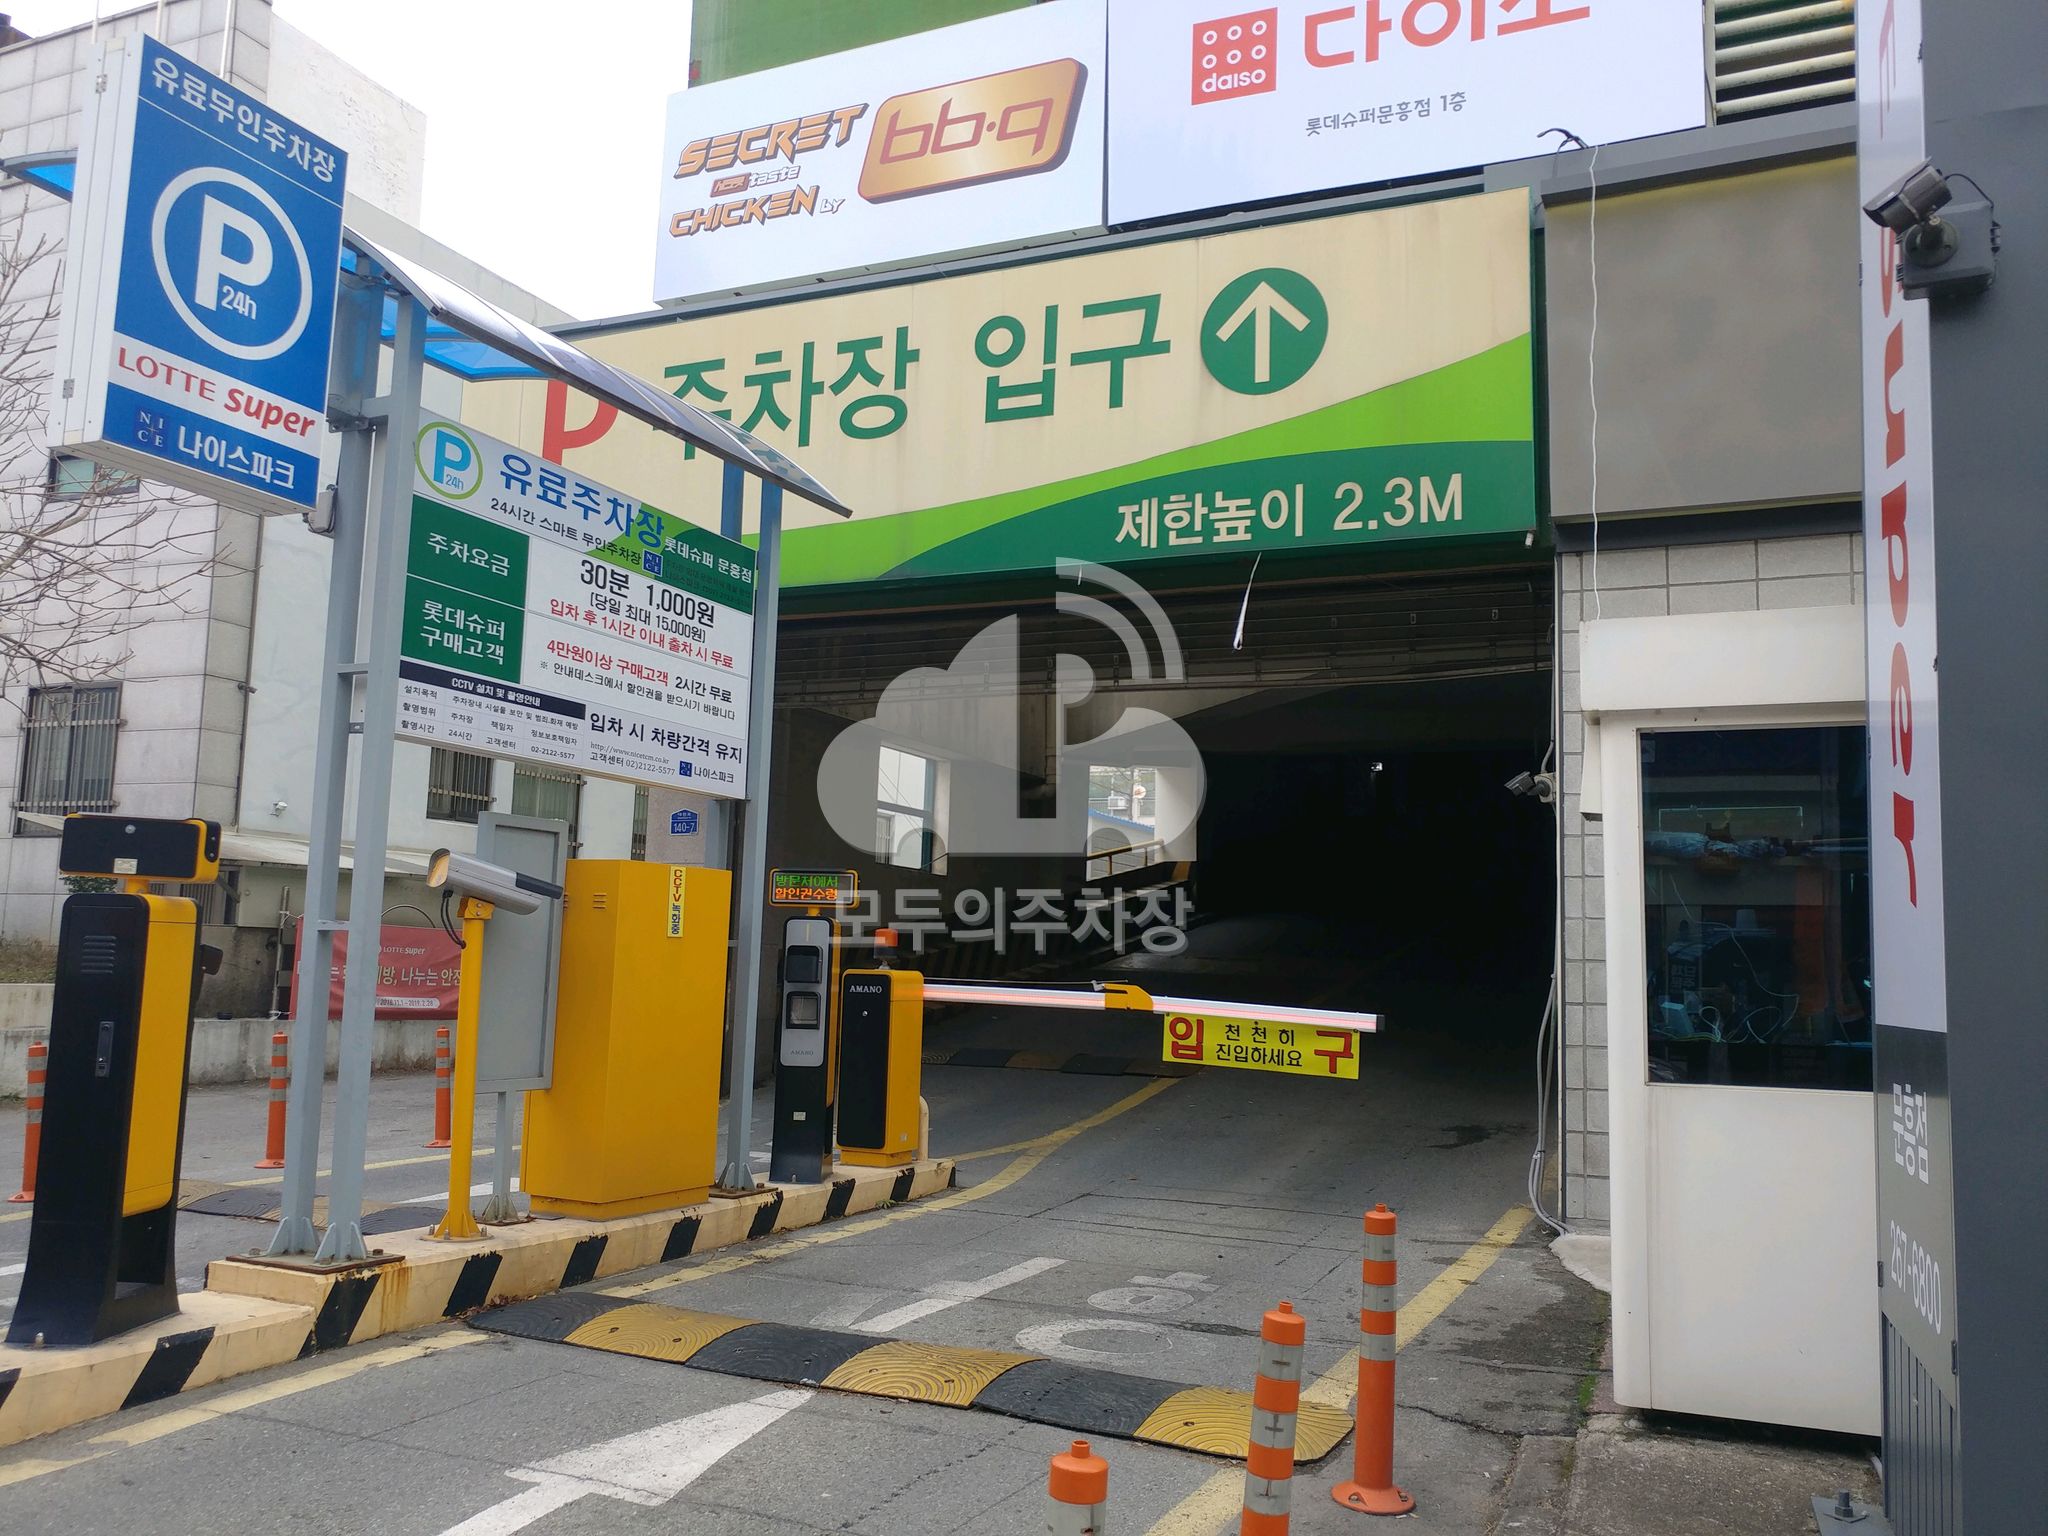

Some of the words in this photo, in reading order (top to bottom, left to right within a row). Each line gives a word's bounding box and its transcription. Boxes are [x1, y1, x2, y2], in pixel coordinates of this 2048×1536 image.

[1201, 69, 1266, 93] daiso
[152, 57, 336, 183] 유료무인주차장
[1305, 98, 1431, 137] 롯데슈퍼문흥점
[1439, 91, 1467, 112] 1층
[673, 102, 869, 179] SECRET
[749, 166, 801, 188] taste
[669, 184, 820, 237] CHICKEN
[194, 193, 275, 312] P
[221, 285, 257, 320] 24h
[118, 347, 217, 402] LOTTE
[223, 388, 316, 438] Super
[653, 325, 921, 460] 주차장
[974, 293, 1172, 424] 입구
[177, 425, 295, 490] 나이스파크
[433, 428, 472, 485] P
[445, 474, 464, 491] 24h
[500, 453, 665, 548] 유료주차장
[490, 497, 536, 526] 24시간
[538, 514, 578, 541] 스마트
[581, 532, 642, 565] 무인주차장
[1115, 484, 1304, 548] 제한높이
[1332, 473, 1464, 532] 2.3M
[427, 532, 511, 576] 주차요금
[664, 536, 714, 568] 롯데슈퍼
[718, 558, 752, 584] 문흥점
[580, 559, 630, 599] 30분
[646, 584, 714, 628] 1,000원
[625, 603, 651, 627] 최대
[422, 600, 505, 641] 롯데슈퍼
[550, 599, 580, 621] 입차
[583, 609, 598, 626] 후
[602, 616, 636, 639] 1시간
[640, 628, 665, 649] 이내
[668, 637, 694, 657] 출차
[696, 647, 708, 662] 시
[711, 650, 734, 669] 무료
[420, 625, 504, 665] 구매고객
[451, 677, 475, 691] CCTV
[476, 682, 494, 696] 설치
[547, 639, 614, 671] 4만원이상
[616, 658, 669, 687] 구매고객
[675, 676, 707, 697] 2시간
[709, 686, 733, 704] 무료
[553, 662, 623, 691] 안내데스크에서
[627, 683, 663, 702] 할인권을
[666, 692, 701, 712] 받으시기
[703, 704, 735, 721] 바랍니다
[448, 729, 473, 742] 24시간
[450, 712, 474, 725] 주차장
[590, 712, 623, 737] 입차
[628, 723, 645, 742] 시
[650, 727, 711, 757] 차량간격
[715, 743, 743, 764] 유지
[485, 736, 517, 750] 고객센터
[589, 751, 625, 768] 고객센터
[625, 758, 676, 776] 02)2122-5577
[694, 765, 735, 784] 나이스파크
[672, 869, 683, 902] CCTV
[401, 966, 438, 986] 나누는
[849, 985, 883, 994] AMANO
[1215, 1043, 1303, 1068] 진입하세요
[1893, 1082, 1929, 1185] 문흥점
